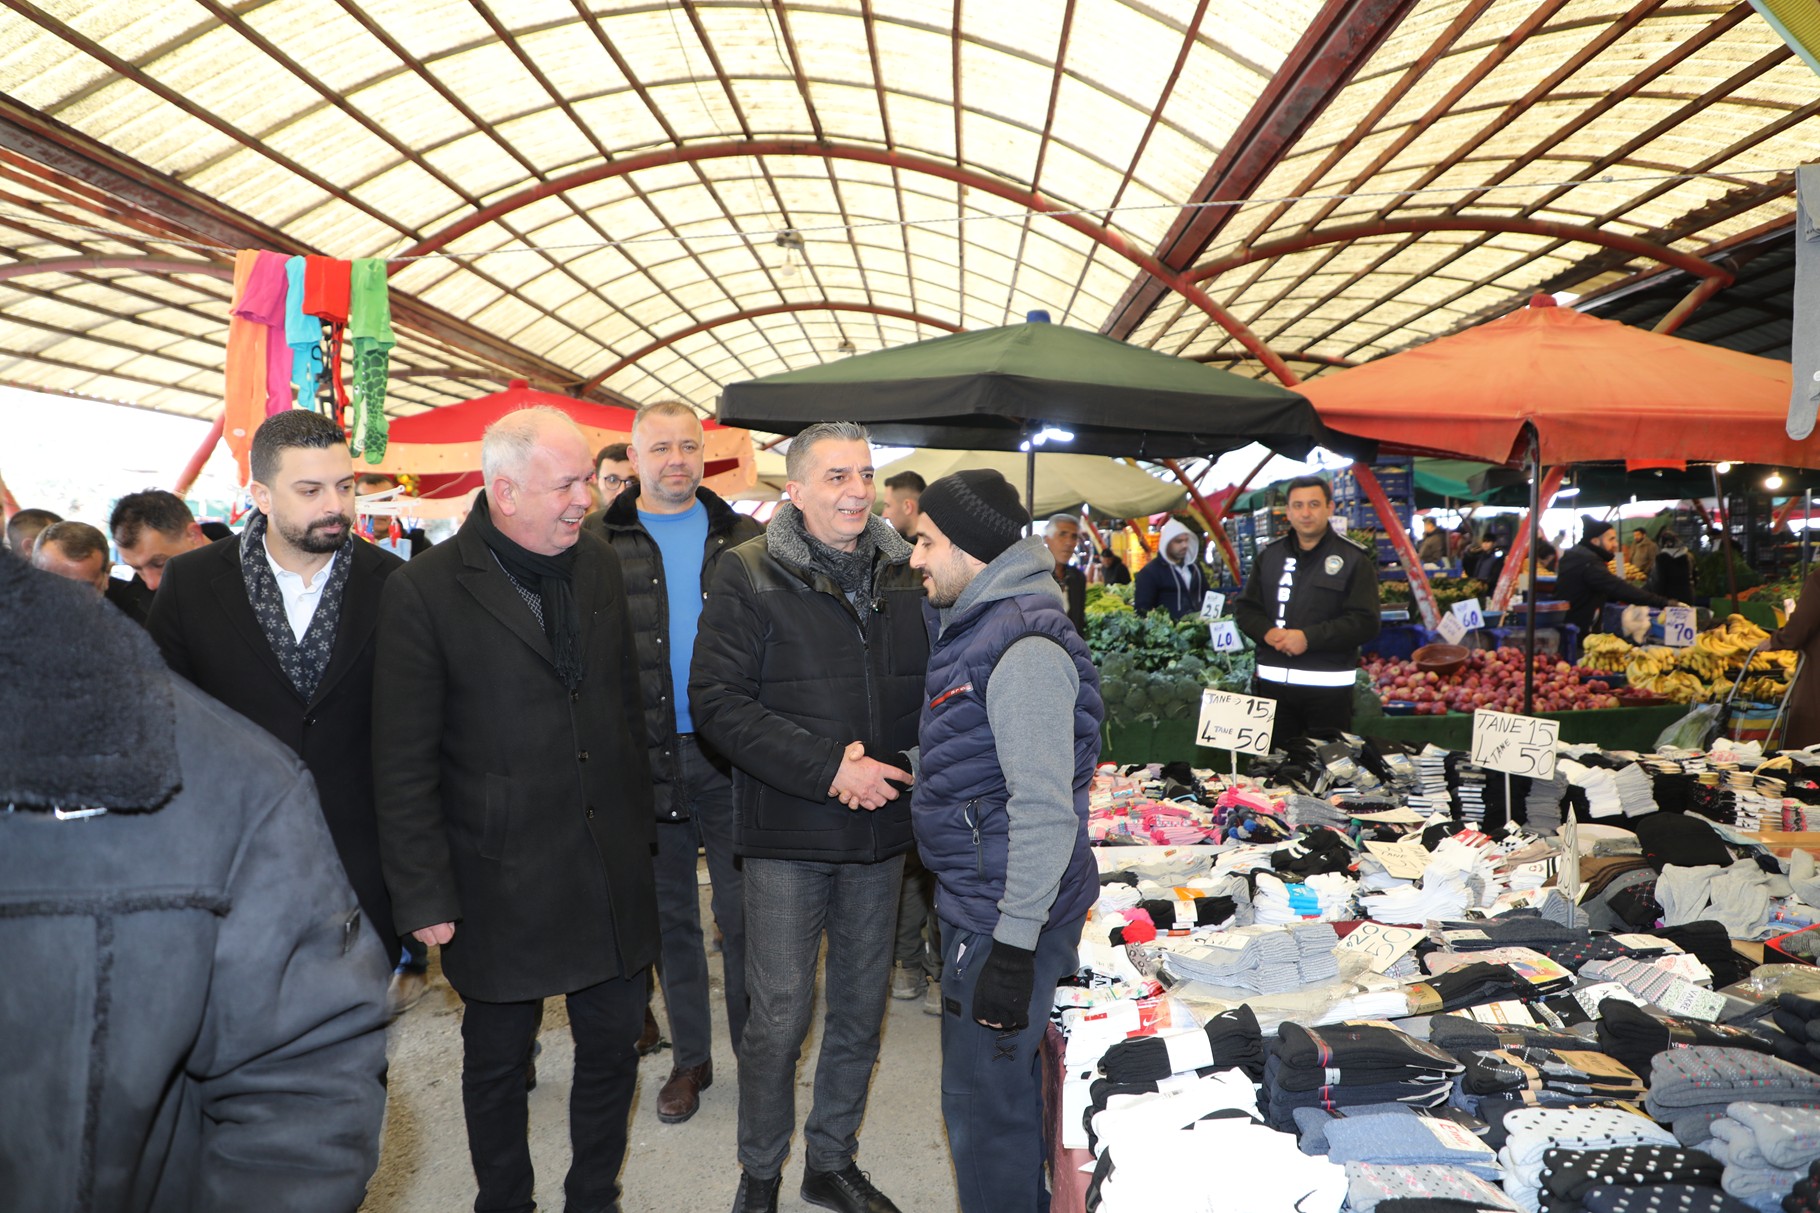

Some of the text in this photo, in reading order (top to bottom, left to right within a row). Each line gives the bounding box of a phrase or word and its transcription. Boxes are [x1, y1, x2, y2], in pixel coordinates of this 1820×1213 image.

[1203, 603, 1220, 619] 25
[1463, 610, 1478, 627] 60
[1674, 623, 1693, 641] 70
[1205, 693, 1231, 704] TANE
[1246, 698, 1269, 718] 15
[1201, 720, 1216, 742] 4
[1234, 728, 1269, 751] 50
[1478, 712, 1556, 747] TANE 15
[1475, 733, 1555, 776] 4 TANE 50
